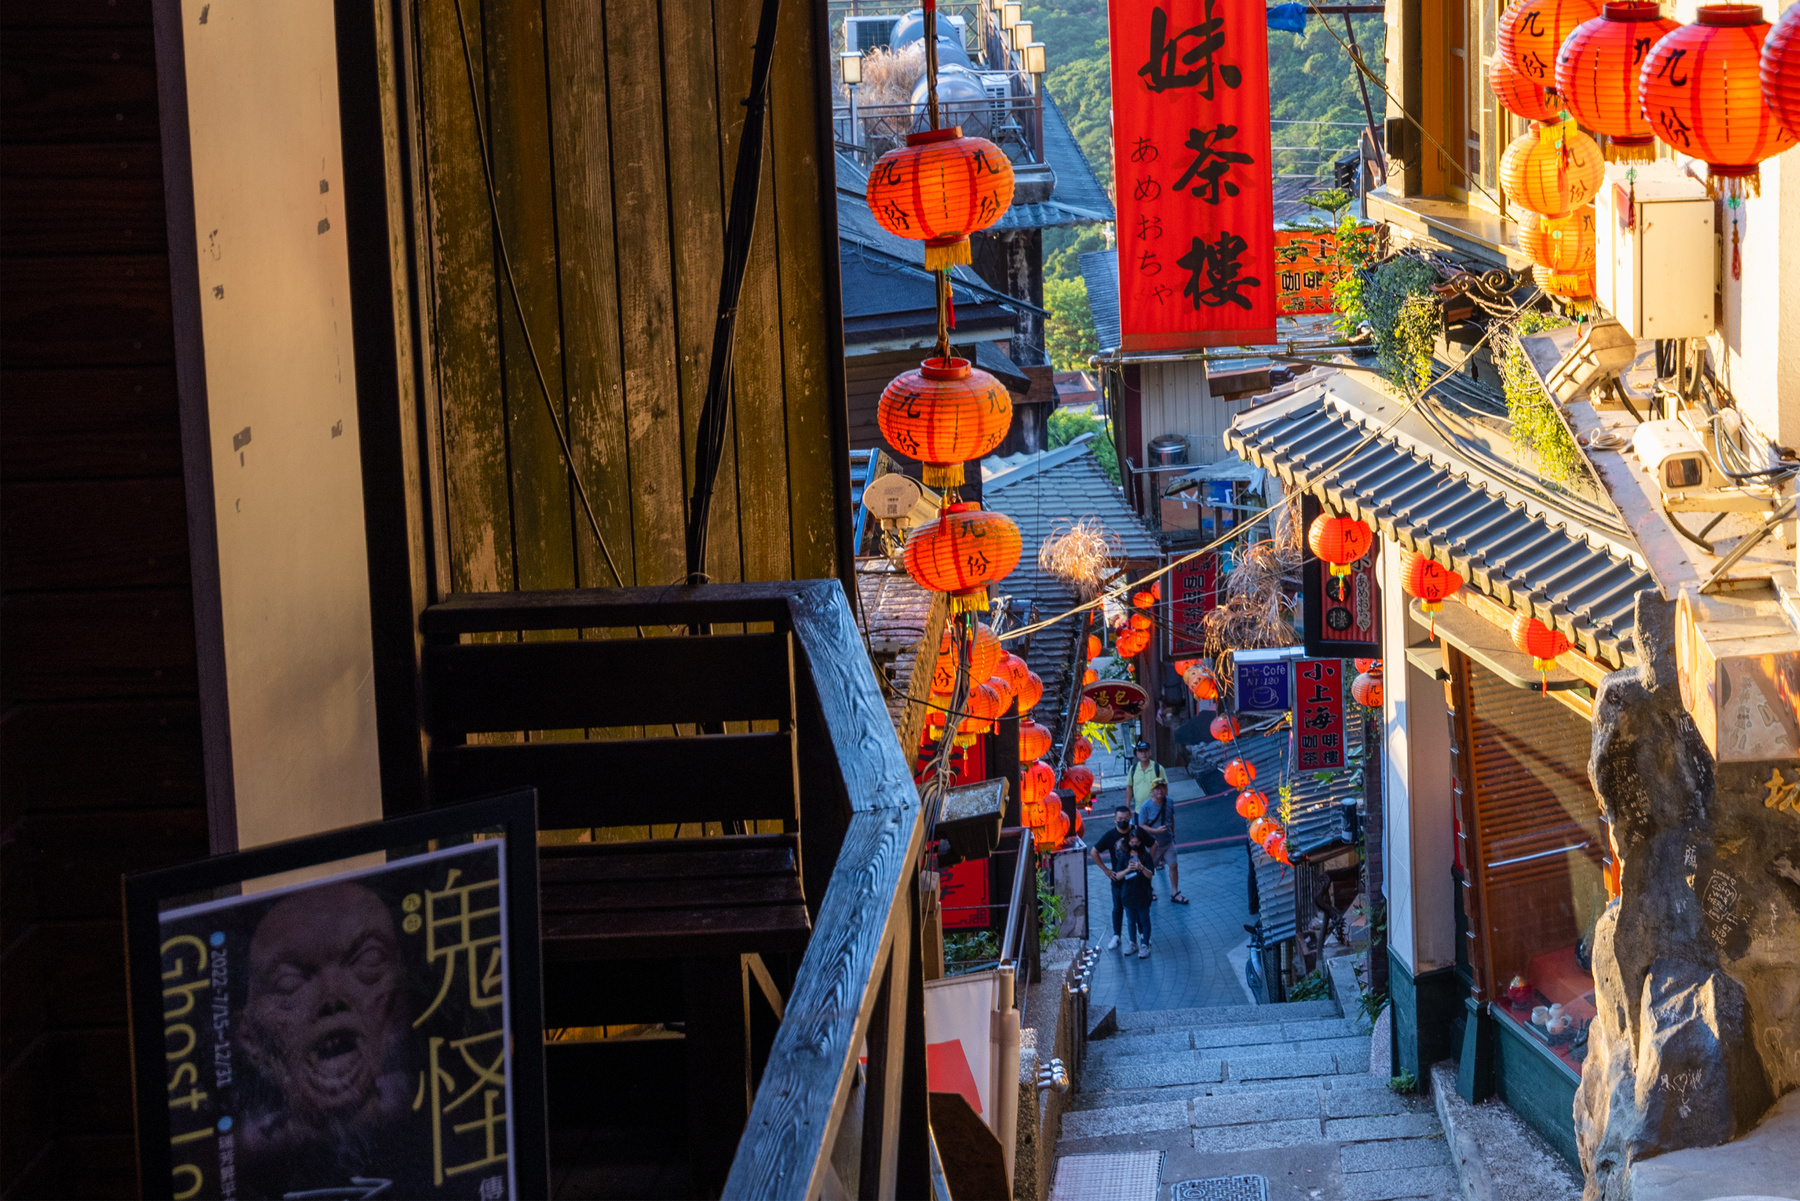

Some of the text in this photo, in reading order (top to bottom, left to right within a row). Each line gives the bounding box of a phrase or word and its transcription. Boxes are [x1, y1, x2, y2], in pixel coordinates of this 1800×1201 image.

[1519, 9, 1548, 80] 九份
[1657, 48, 1692, 149] 九份
[879, 158, 910, 231] 九份
[972, 149, 1001, 224] 九份
[897, 391, 921, 456] 九份
[962, 519, 991, 578] 九份
[1424, 563, 1440, 598] 九份
[1303, 662, 1338, 730] 小上海
[1301, 733, 1339, 749] 咖啡
[1302, 750, 1339, 766] 茶樓
[160, 934, 211, 1112] Ghost
[412, 868, 509, 1186] 鬼怪
